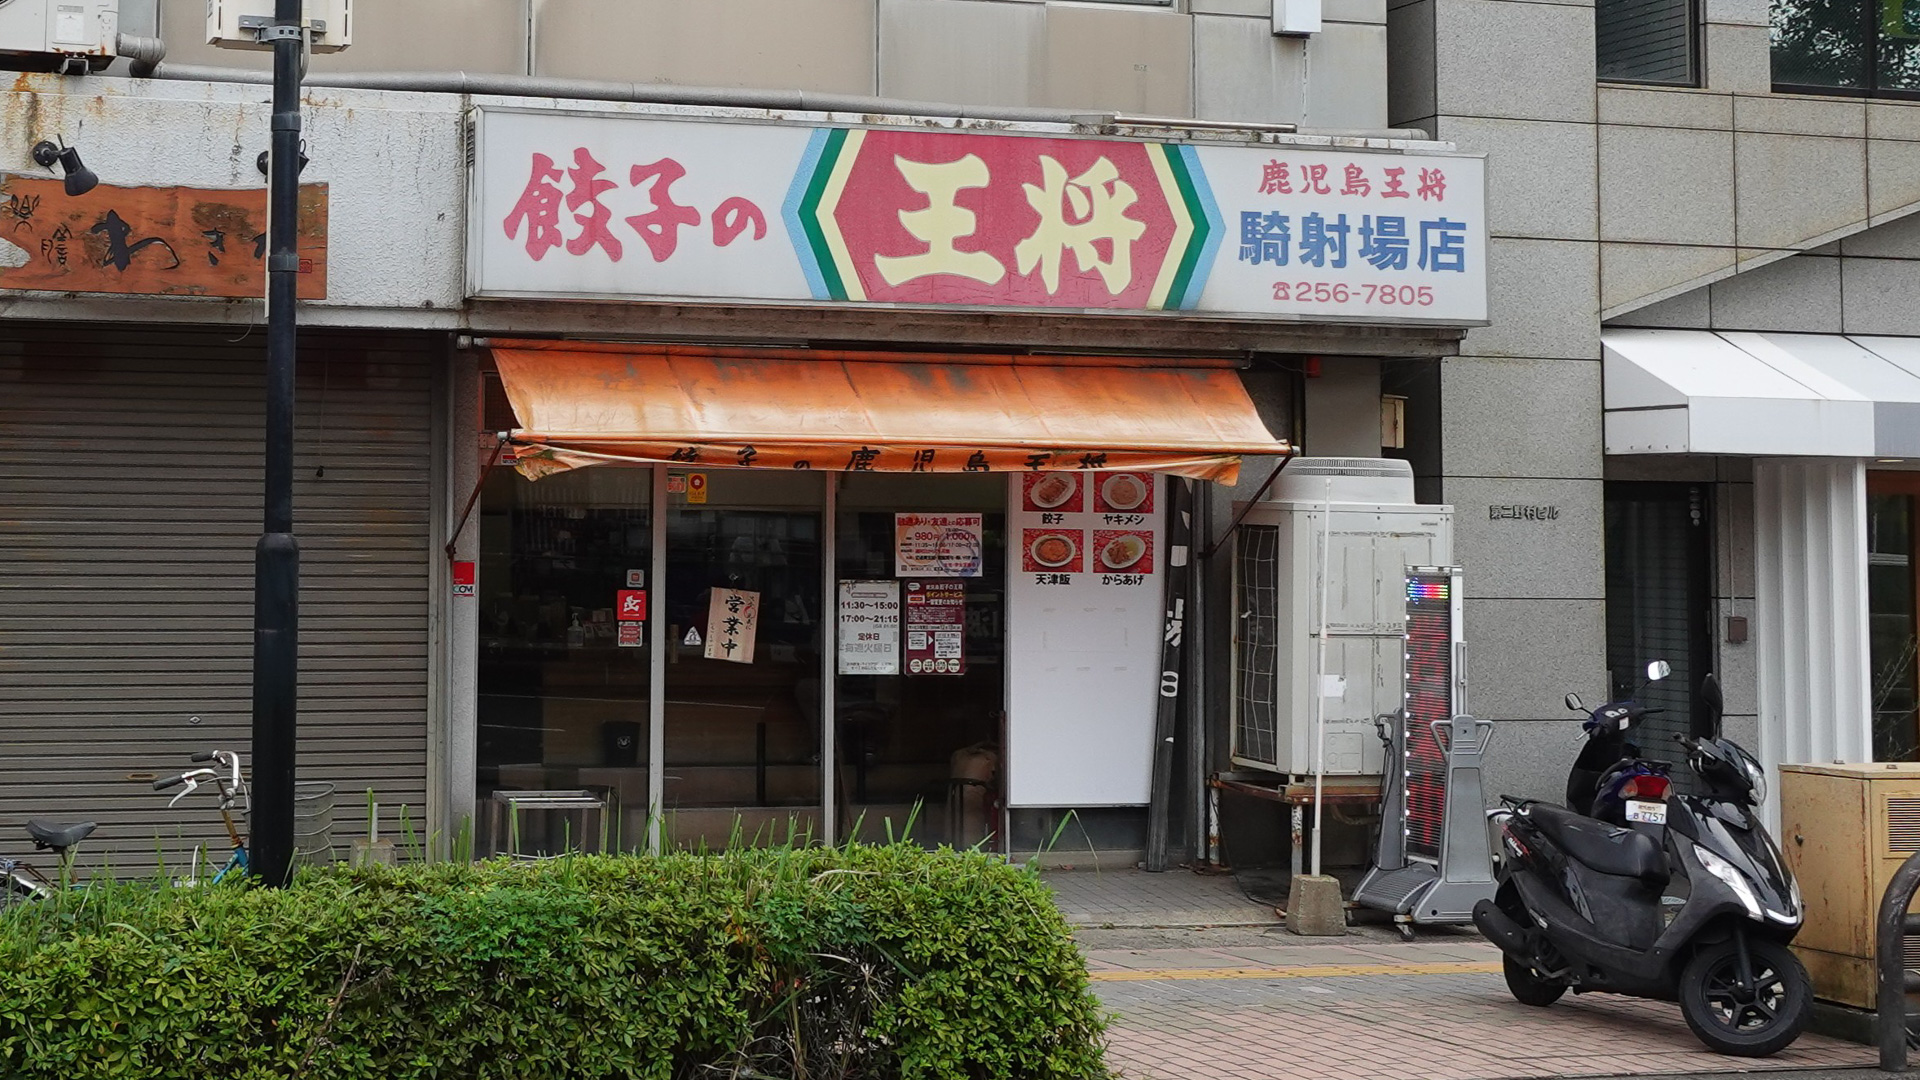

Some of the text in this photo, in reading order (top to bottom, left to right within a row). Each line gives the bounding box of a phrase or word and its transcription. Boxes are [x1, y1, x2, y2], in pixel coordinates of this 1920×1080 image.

[1258, 159, 1447, 202] 鹿児島王将
[504, 147, 1147, 295] 餃子の 王将
[1239, 210, 1467, 273] 騎射場店
[1296, 281, 1434, 306] 256-7805
[1042, 513, 1064, 525] 餃子
[1103, 514, 1145, 525] ヤキメシ
[1035, 574, 1070, 585] 天津飯
[1102, 574, 1145, 586] からあげ
[721, 594, 745, 658] 営業中
[858, 632, 880, 641] 定休日
